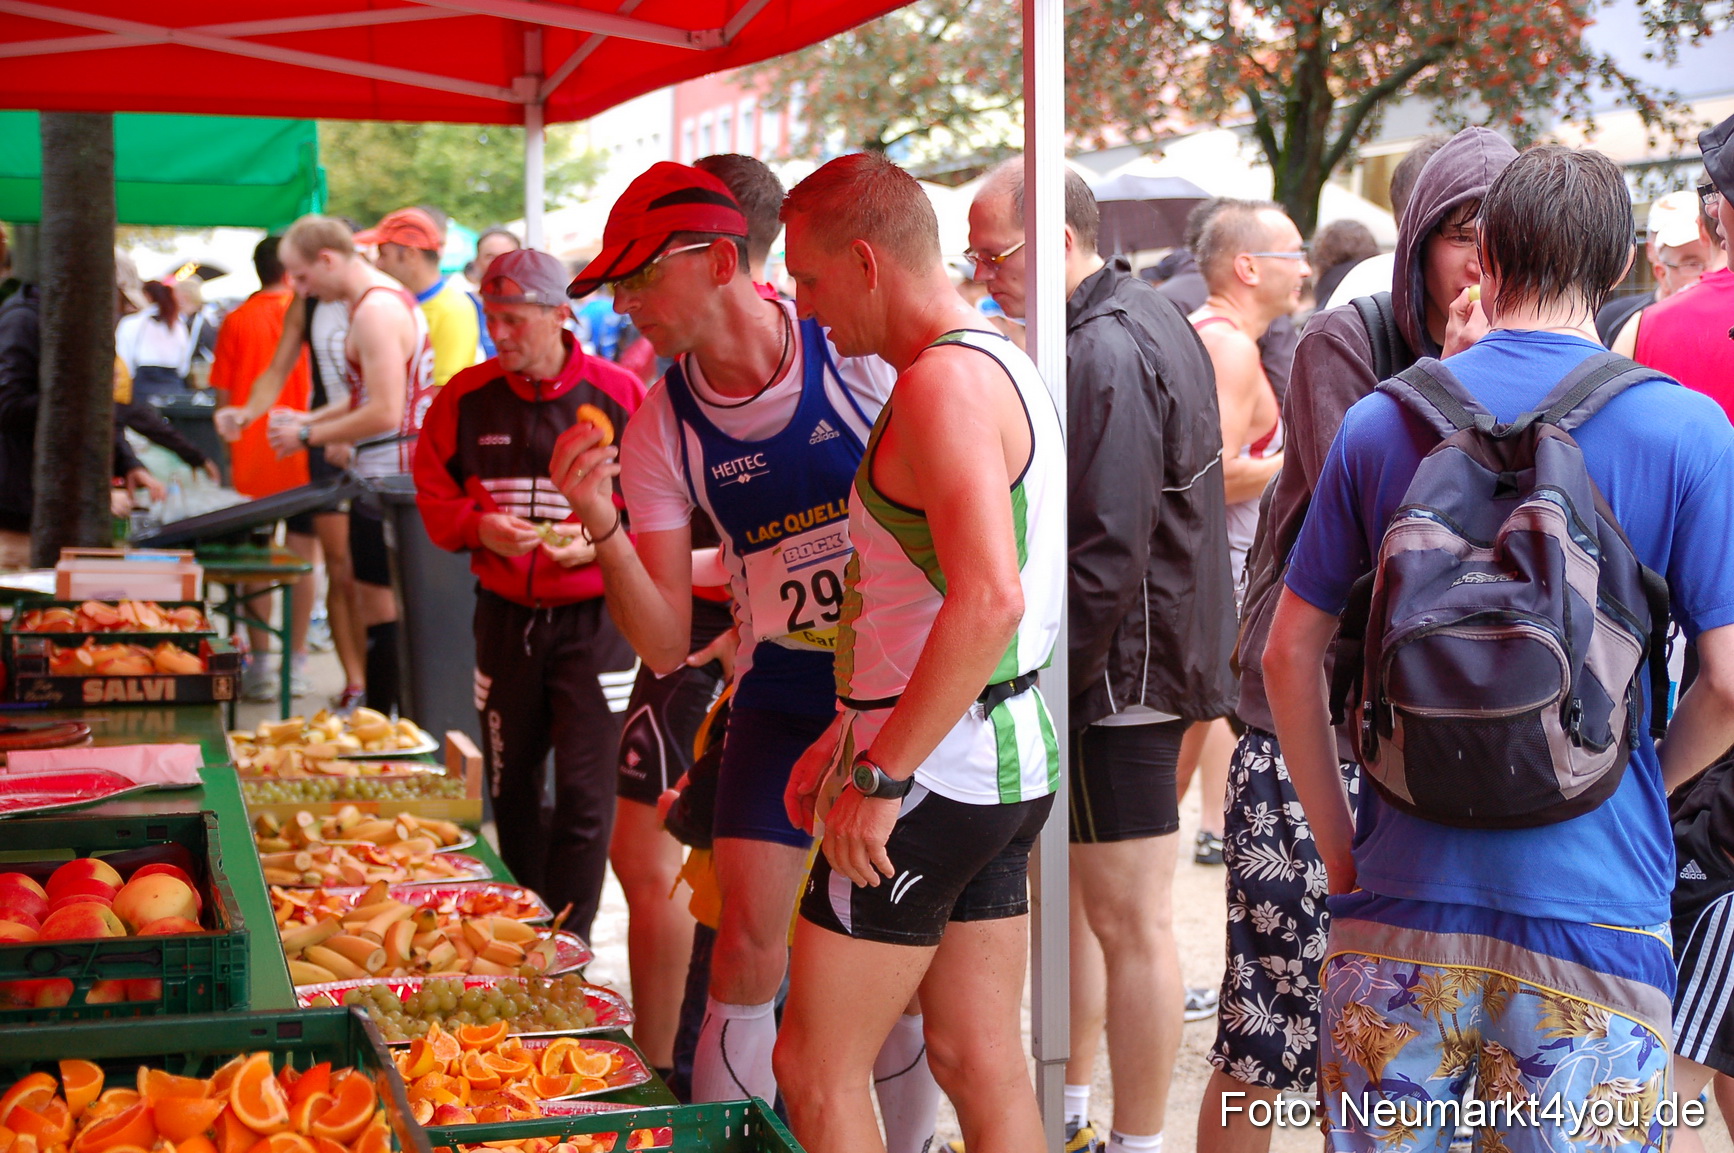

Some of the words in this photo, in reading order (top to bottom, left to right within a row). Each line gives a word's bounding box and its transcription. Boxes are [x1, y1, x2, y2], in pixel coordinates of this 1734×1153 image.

[809, 430, 840, 445] adidas
[711, 453, 767, 479] HEITEC
[746, 521, 782, 544] LAC
[783, 533, 844, 564] BOCK
[82, 678, 177, 702] SALVI
[1680, 872, 1707, 880] adidas
